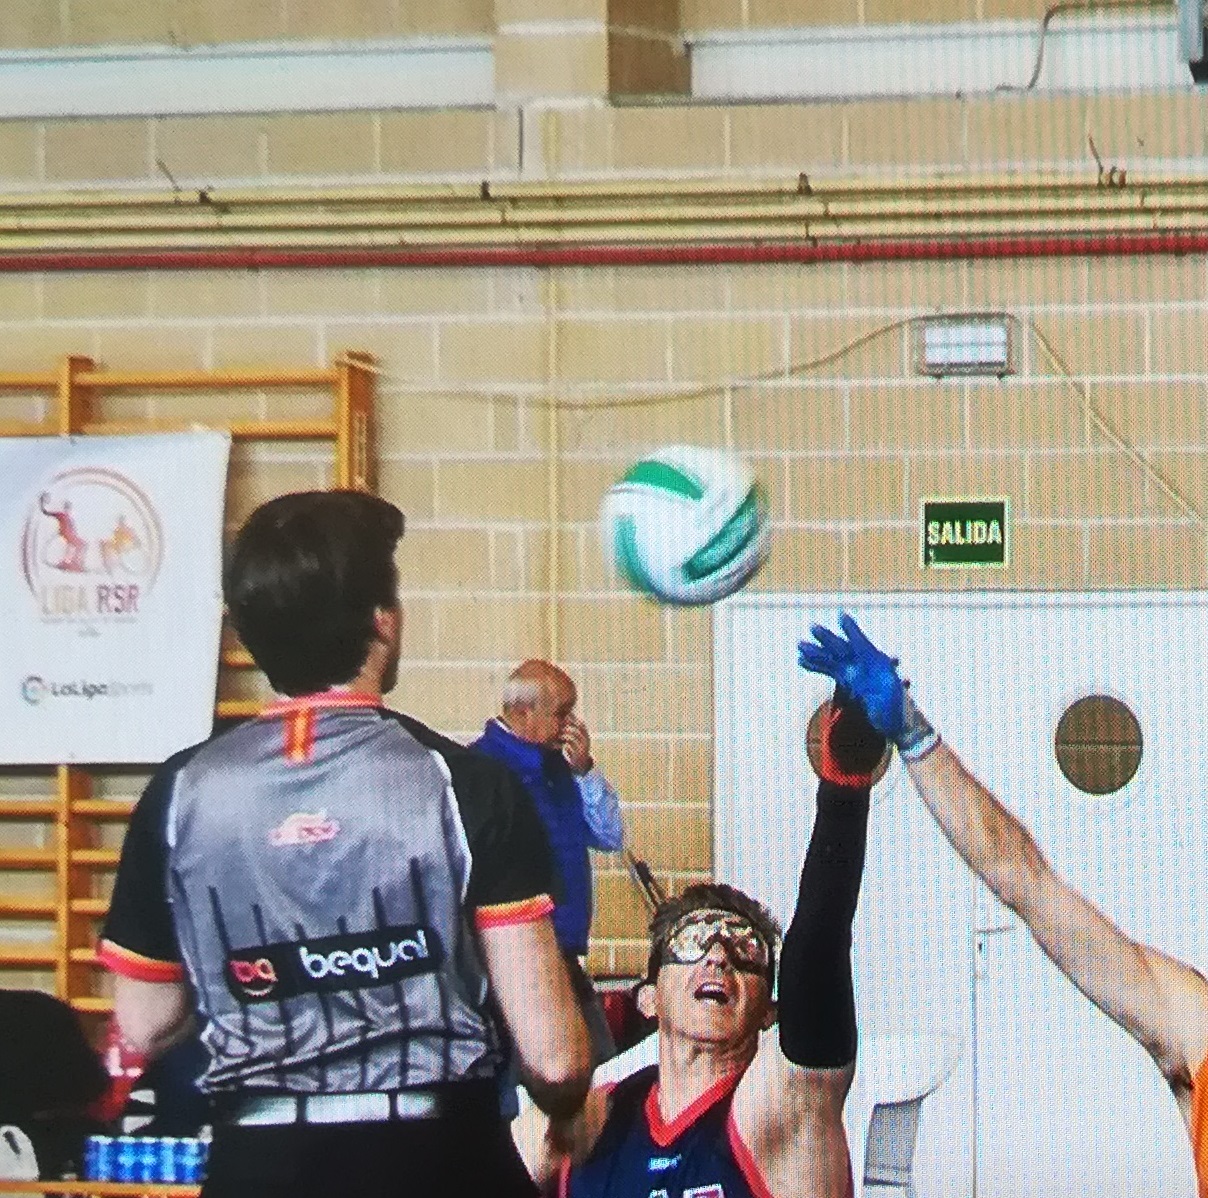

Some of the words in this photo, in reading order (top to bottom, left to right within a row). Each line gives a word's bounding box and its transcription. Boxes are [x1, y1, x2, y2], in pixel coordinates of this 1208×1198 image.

[927, 519, 1002, 545] SALIDA
[41, 585, 89, 615] LIGA
[96, 584, 140, 615] RSR
[299, 930, 429, 979] bequal
